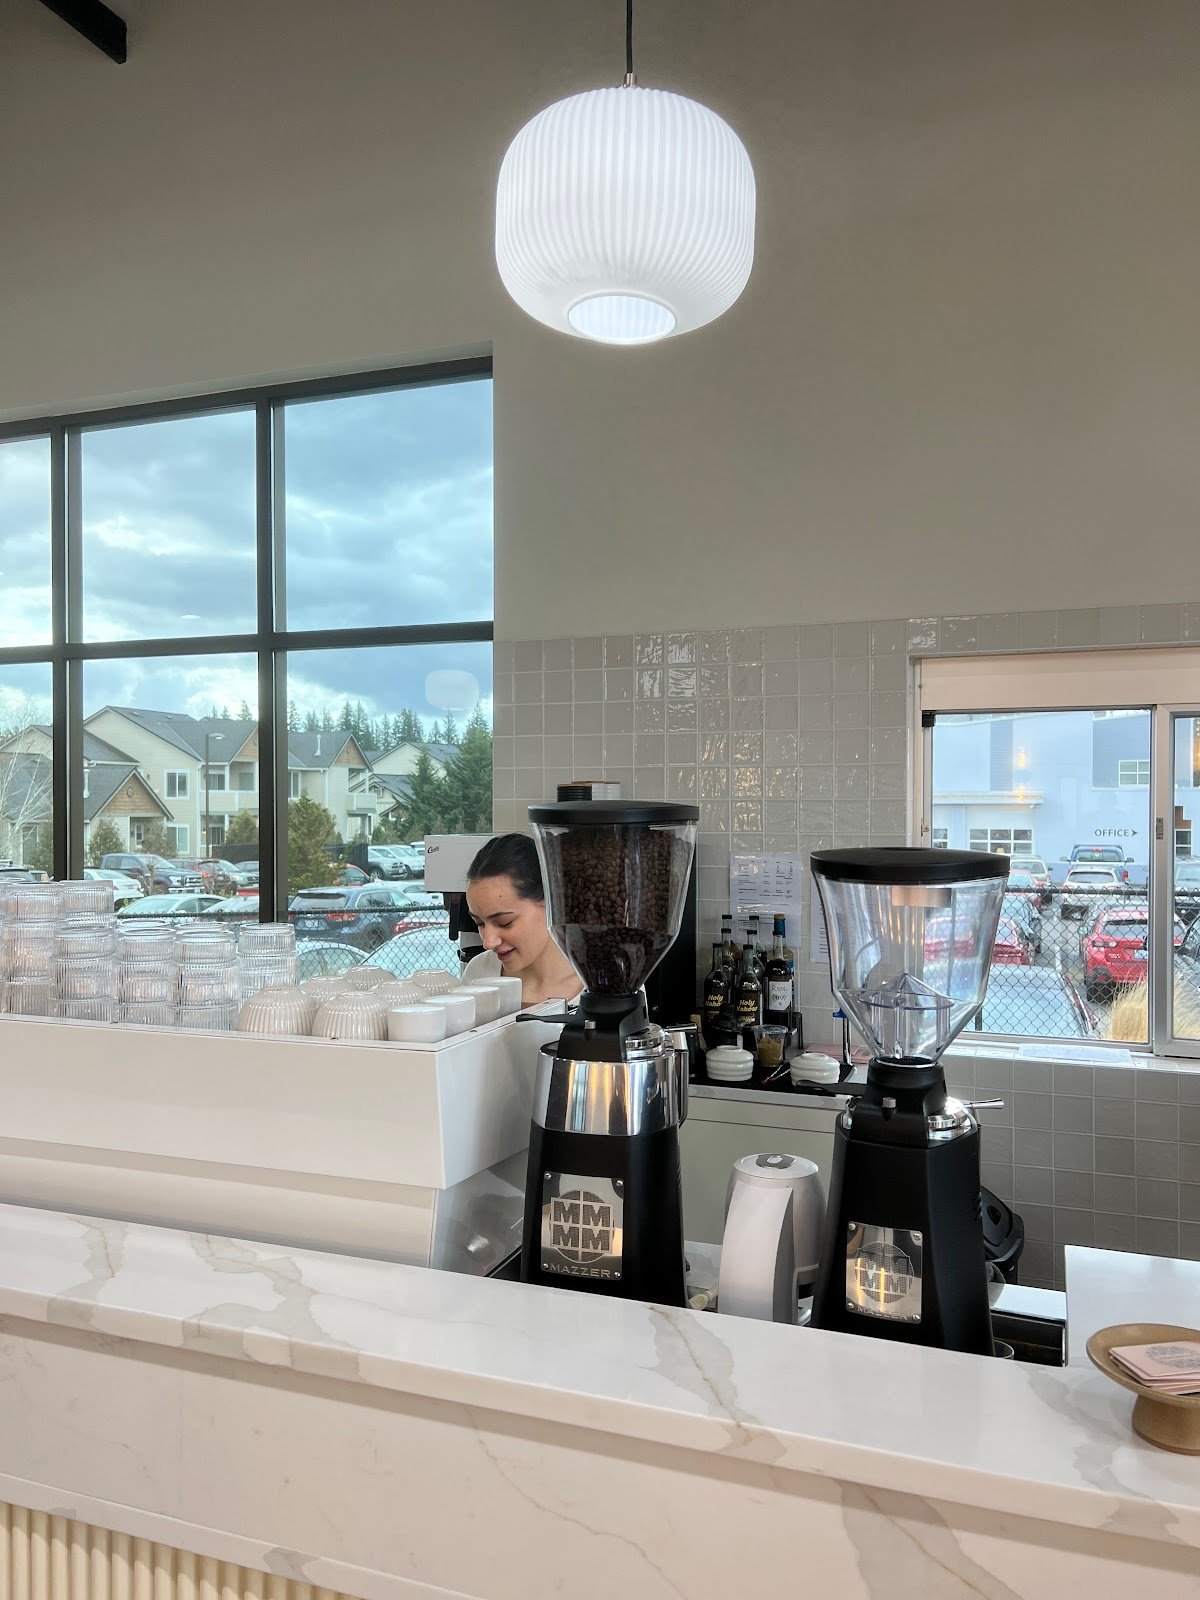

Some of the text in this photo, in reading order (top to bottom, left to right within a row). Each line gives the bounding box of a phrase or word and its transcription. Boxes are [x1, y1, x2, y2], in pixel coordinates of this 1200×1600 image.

[1094, 828, 1129, 837] OFFICE
[708, 994, 724, 1002] Holy
[739, 999, 756, 1007] Holy
[550, 1264, 610, 1278] MAZZER
